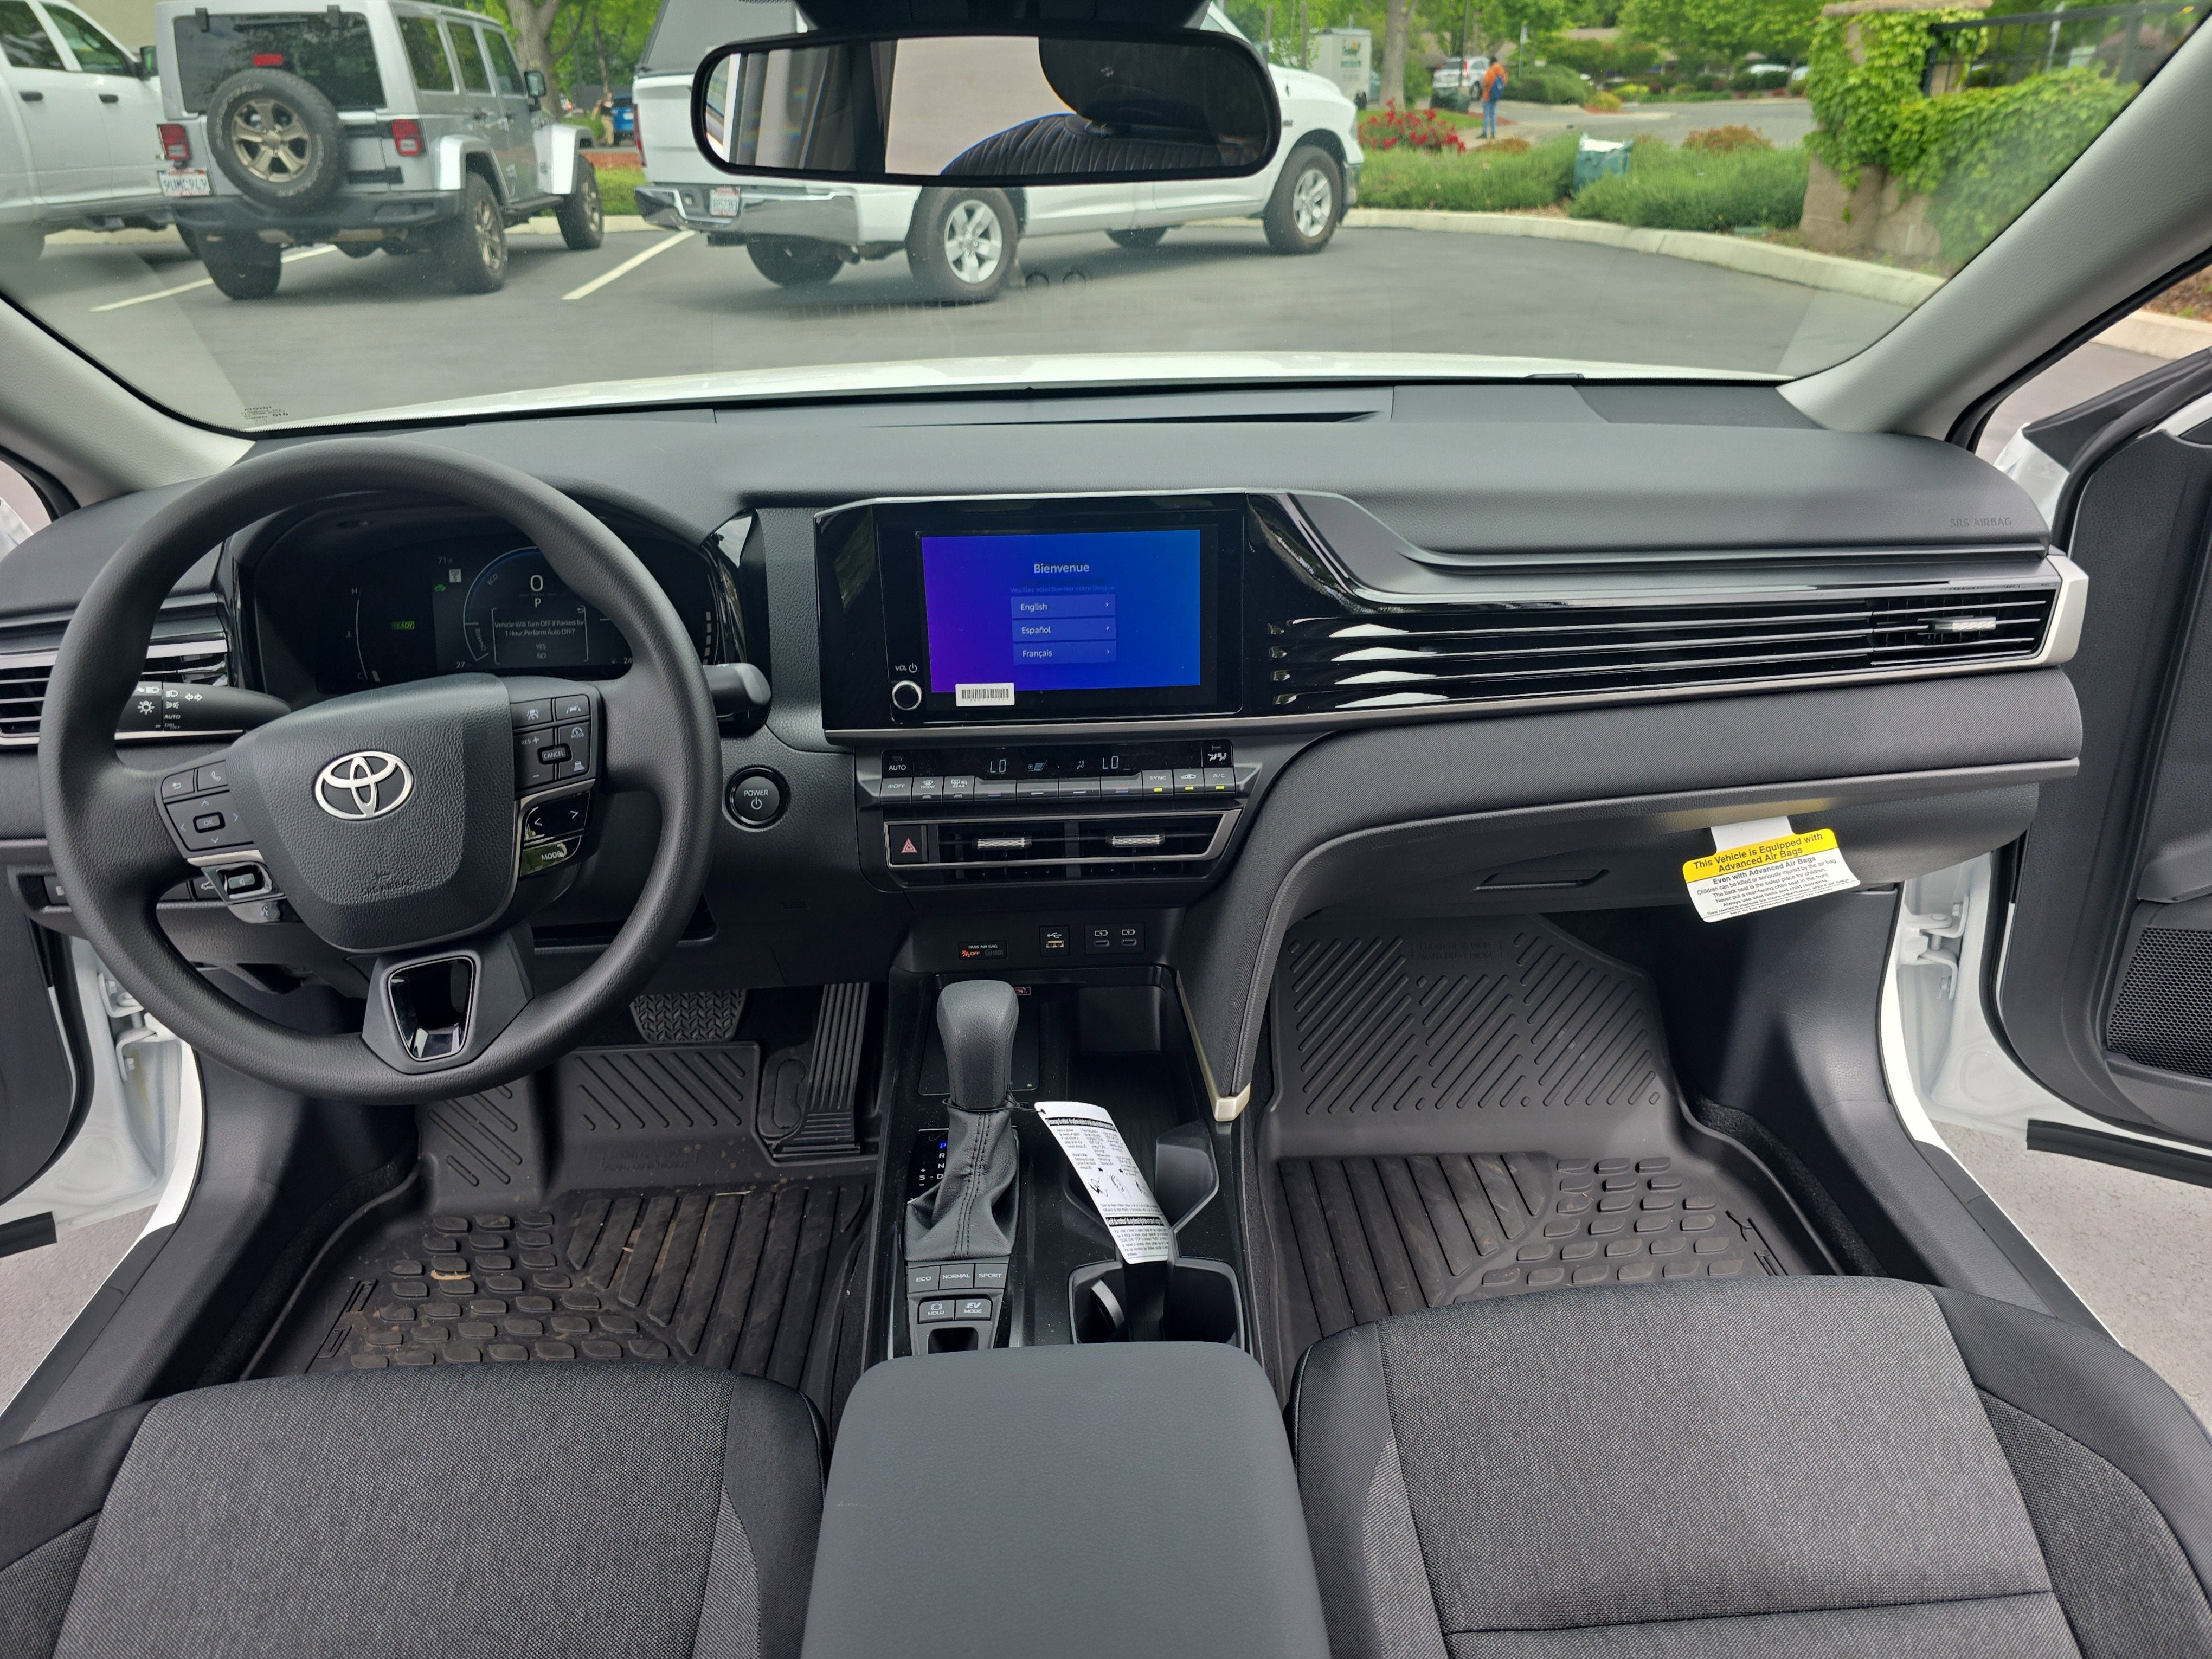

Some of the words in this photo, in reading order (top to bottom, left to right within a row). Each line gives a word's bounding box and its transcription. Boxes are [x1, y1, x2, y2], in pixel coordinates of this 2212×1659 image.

[1950, 518, 1969, 528] SRS
[1973, 517, 2012, 527] AIRBAG
[1034, 563, 1090, 574] Bienvenue
[1092, 584, 1115, 593] langue
[535, 597, 542, 608] P
[1020, 603, 1047, 613] English
[394, 621, 414, 630] EADY
[1021, 626, 1051, 635] Español
[1023, 649, 1053, 659] Français
[544, 750, 564, 759] CANCEL
[1693, 859, 1713, 869] This
[1714, 851, 1747, 864] Vehicle
[1749, 848, 1757, 856] is
[1759, 838, 1802, 854] Equipped
[1804, 833, 1823, 843] with
[1719, 856, 1763, 872] Advanced
[1765, 853, 1777, 861] Air
[1780, 847, 1803, 858] Bags
[1713, 876, 1731, 885] Even
[1732, 872, 1747, 880] with
[1749, 864, 1784, 876] Advanced
[1798, 857, 1816, 865] Bags
[1697, 886, 1719, 895] Children
[1759, 871, 1782, 881] seriously
[1782, 867, 1801, 875] injured
[1782, 875, 1796, 883] place
[1747, 884, 1774, 896] rear-facing
[1719, 904, 1738, 912] owner's
[1782, 888, 1811, 898] information
[1723, 899, 1742, 908] Always
